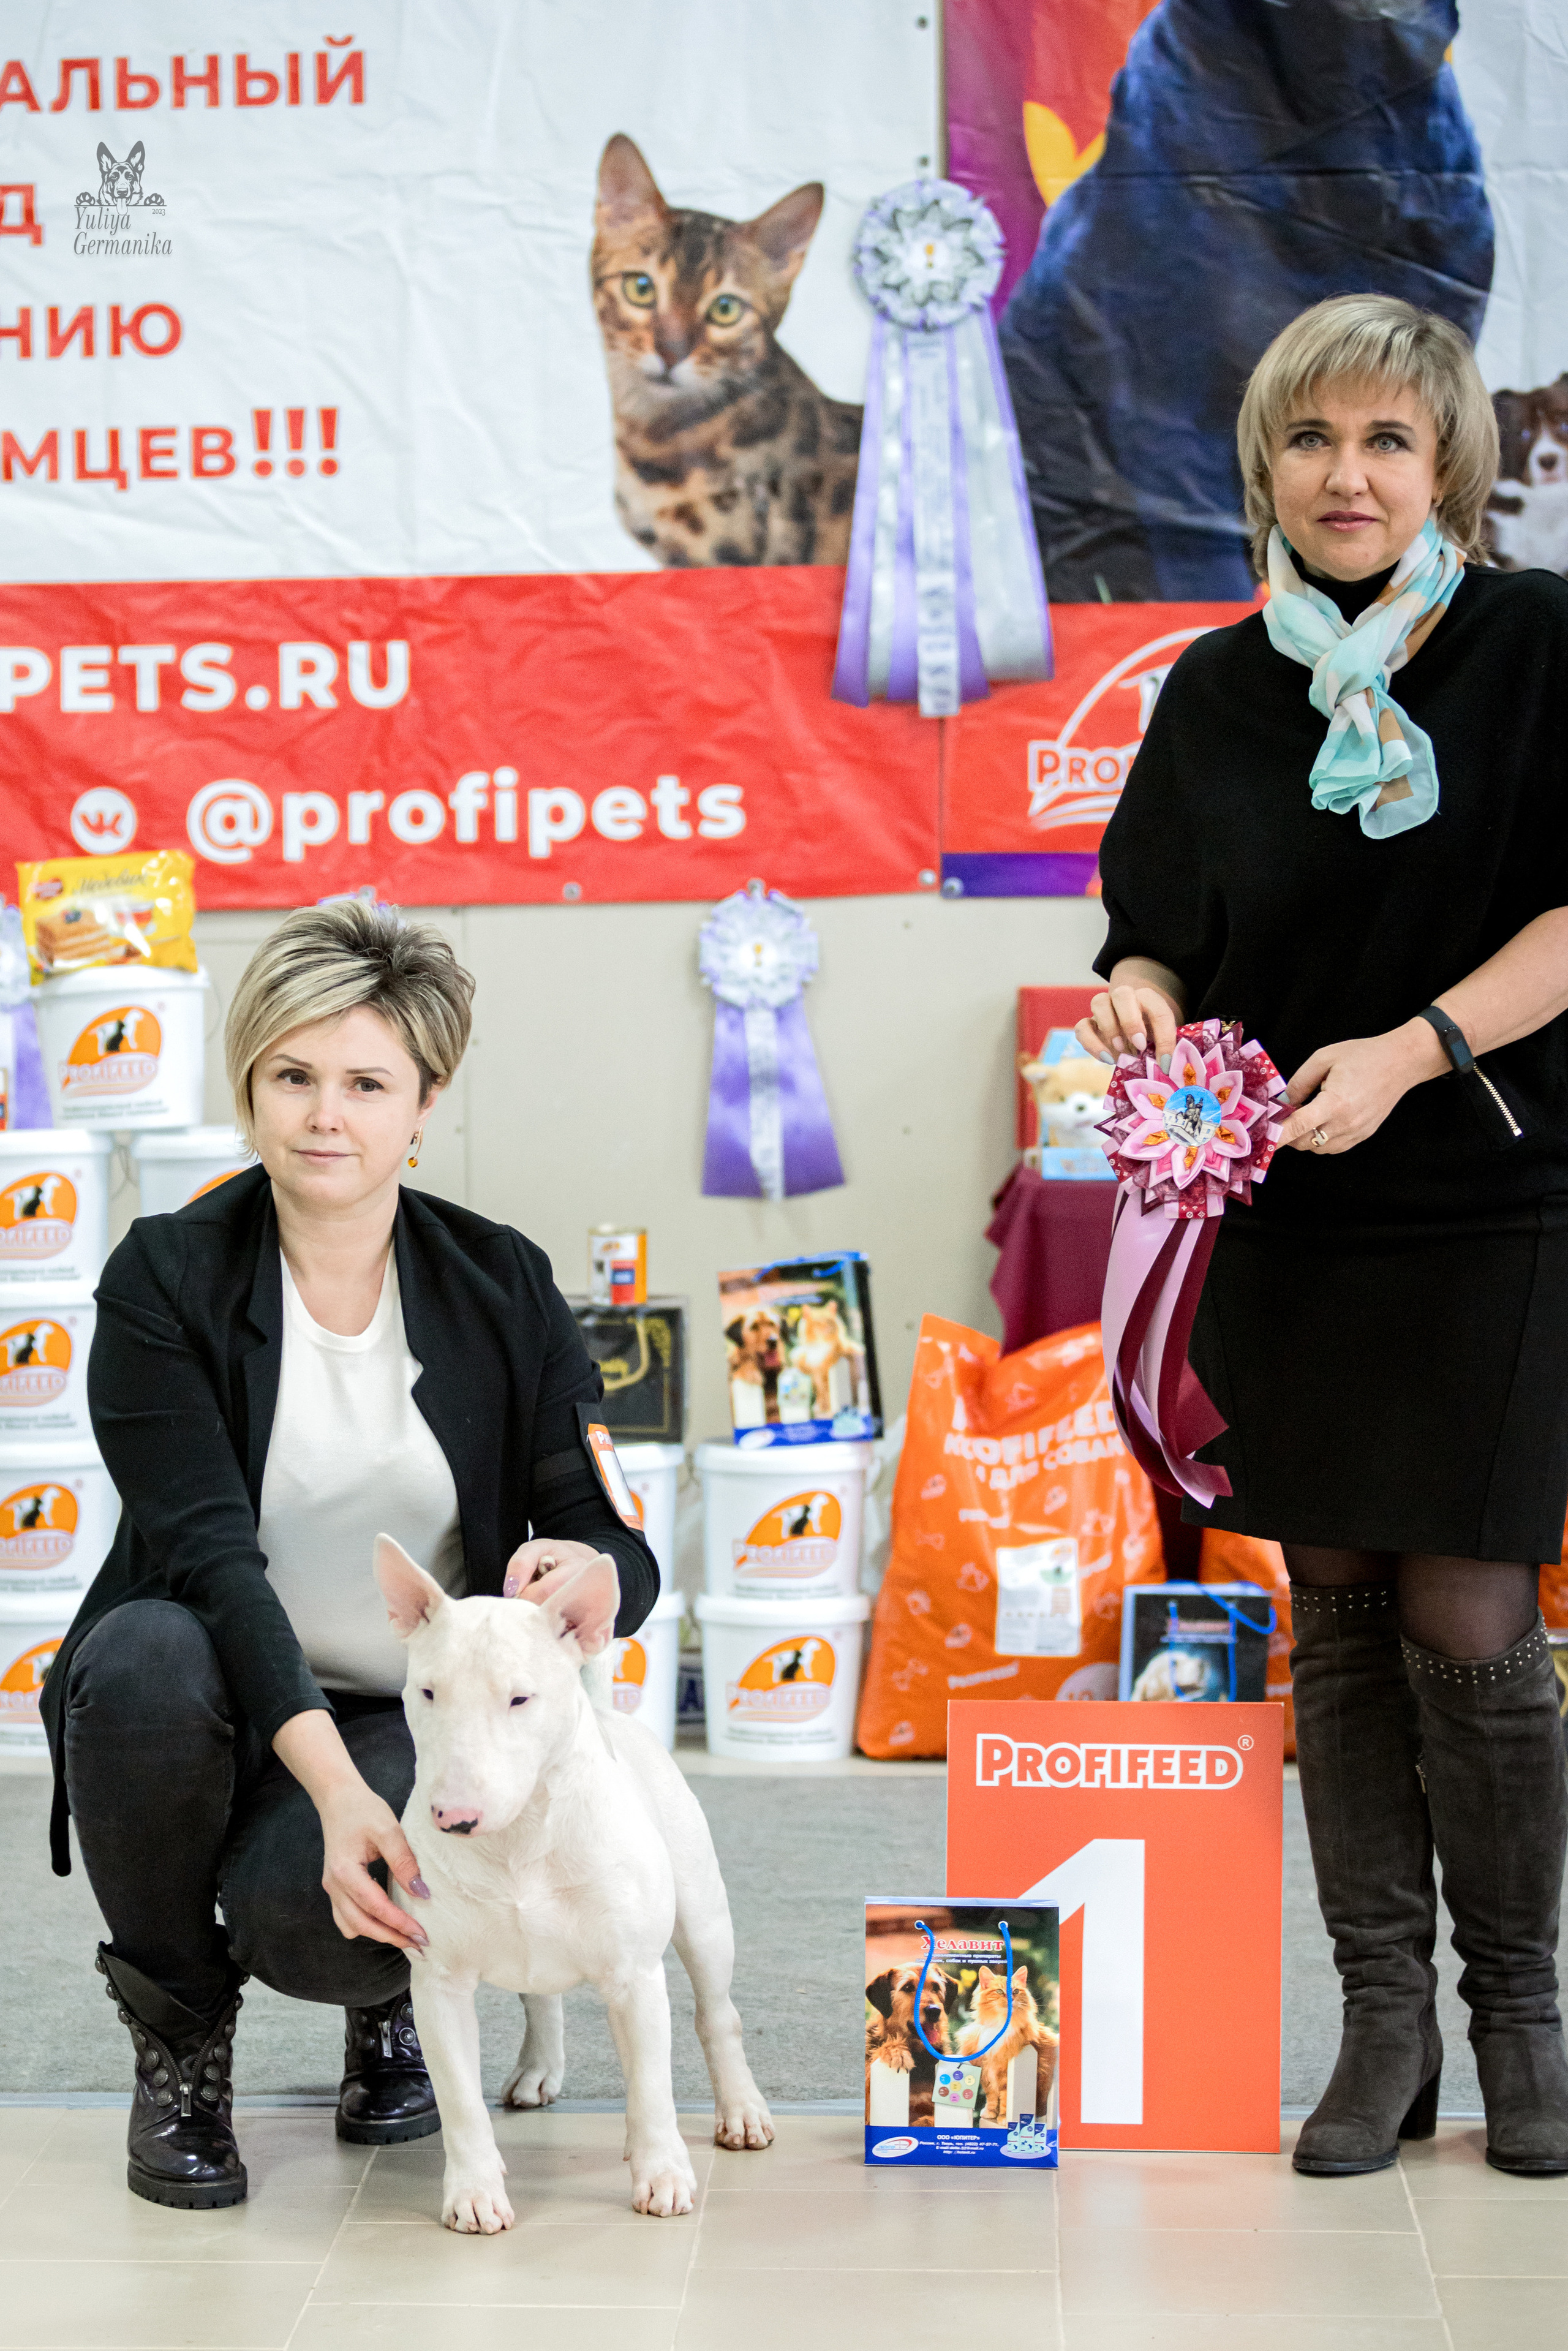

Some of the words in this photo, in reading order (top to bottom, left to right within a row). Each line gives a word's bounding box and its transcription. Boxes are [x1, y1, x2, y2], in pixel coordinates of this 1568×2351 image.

[0, 35, 366, 113] АЛЬНЫЙ
[0, 640, 410, 713] PETS.RU
[186, 767, 747, 864] @profipets
[976, 1734, 1243, 1789] PROFIFEED
[921, 1935, 1005, 1951] Хелавит
[1017, 1839, 1145, 2124] 1
